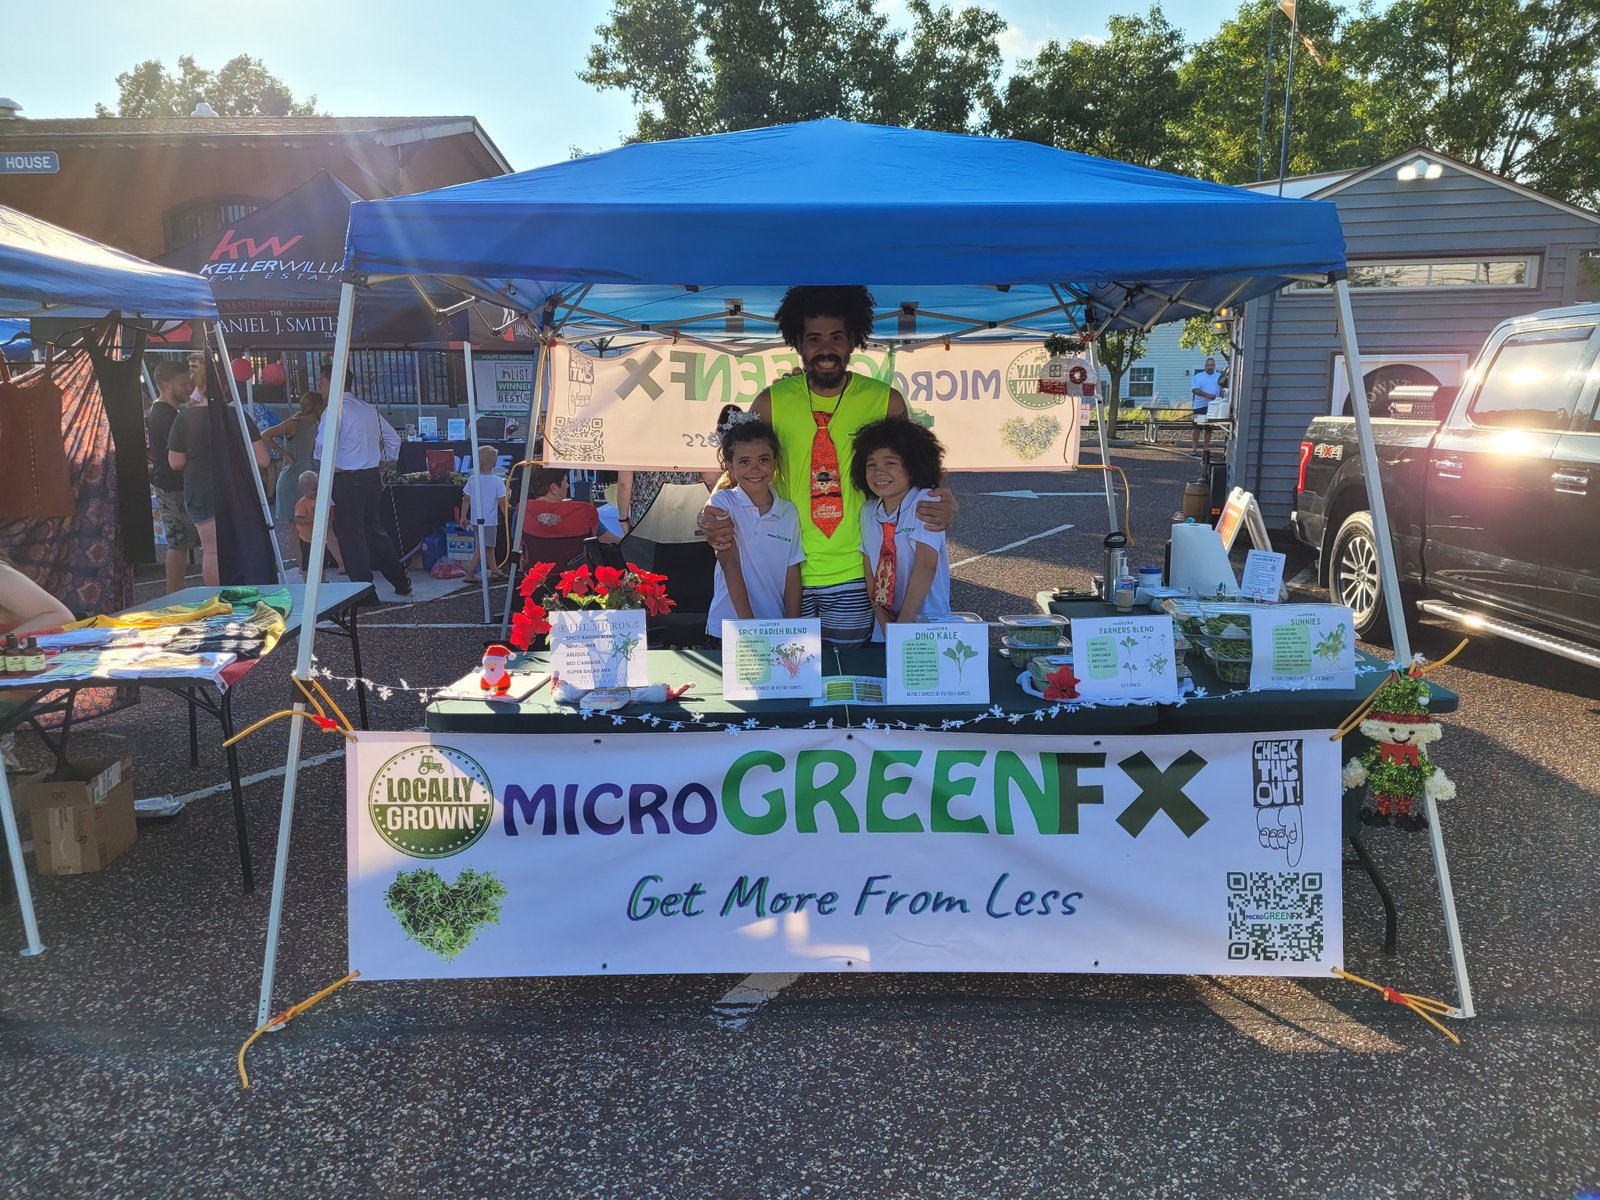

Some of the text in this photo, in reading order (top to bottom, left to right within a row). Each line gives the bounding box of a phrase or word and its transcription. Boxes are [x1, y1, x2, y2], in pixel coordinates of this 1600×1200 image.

[5, 156, 52, 169] HOUSE
[208, 273, 336, 283] EAL ESTAT
[275, 317, 285, 336] J.
[286, 316, 340, 333] SMITH
[498, 394, 520, 402] BEST
[817, 504, 837, 514] Merry
[813, 510, 842, 520] Christmas
[1290, 617, 1321, 626] SUNNIES
[738, 627, 808, 636] SPICY RADISH BLEND
[1099, 625, 1154, 635] FARMERS BLEND
[915, 631, 958, 640] DINO KALE
[1254, 740, 1299, 760] CHECK
[1258, 759, 1298, 781] THIS
[387, 777, 475, 803] LOCALLY
[1256, 781, 1301, 805] OUT!
[386, 806, 474, 830] GROWN
[626, 872, 1084, 921] Get More From Less
[1246, 911, 1304, 921] MICROGREENFX
